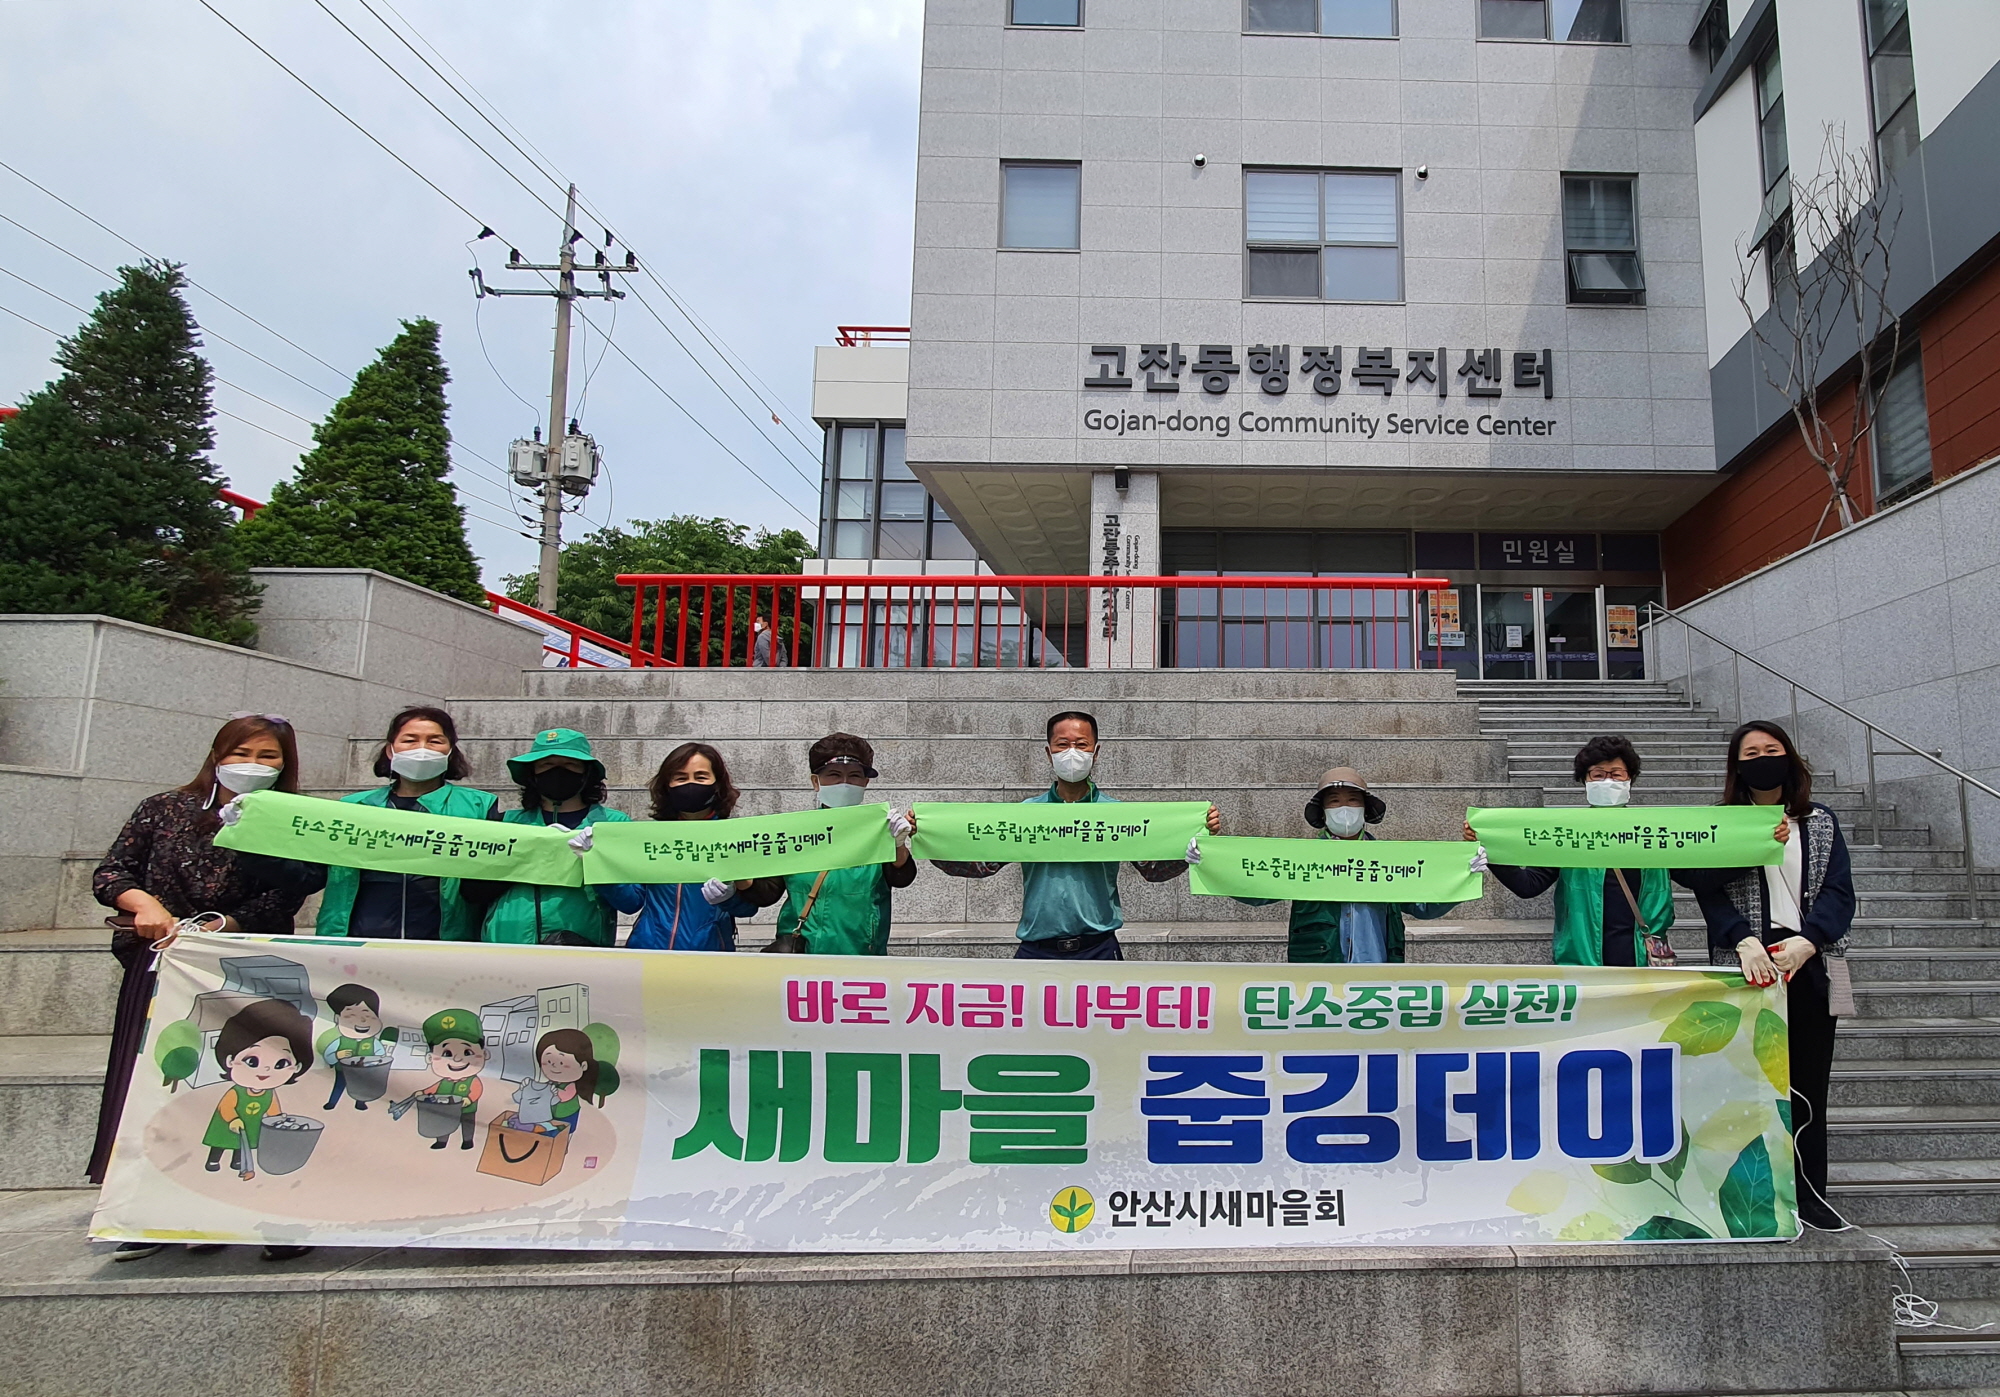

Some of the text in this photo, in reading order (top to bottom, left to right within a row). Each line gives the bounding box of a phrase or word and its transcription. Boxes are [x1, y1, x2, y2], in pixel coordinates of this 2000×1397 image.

[1083, 342, 1554, 400] 고잔동행정복지센터
[1084, 409, 1557, 440] Gojan-dong Community Service Center
[1502, 540, 1575, 564] 민원실
[787, 980, 1577, 1030] 바로 지금! 나부터! 탄소중립 실천!
[671, 1048, 1680, 1165] 새마을 줍깅데이
[1108, 1189, 1345, 1228] 안산시새마을회
